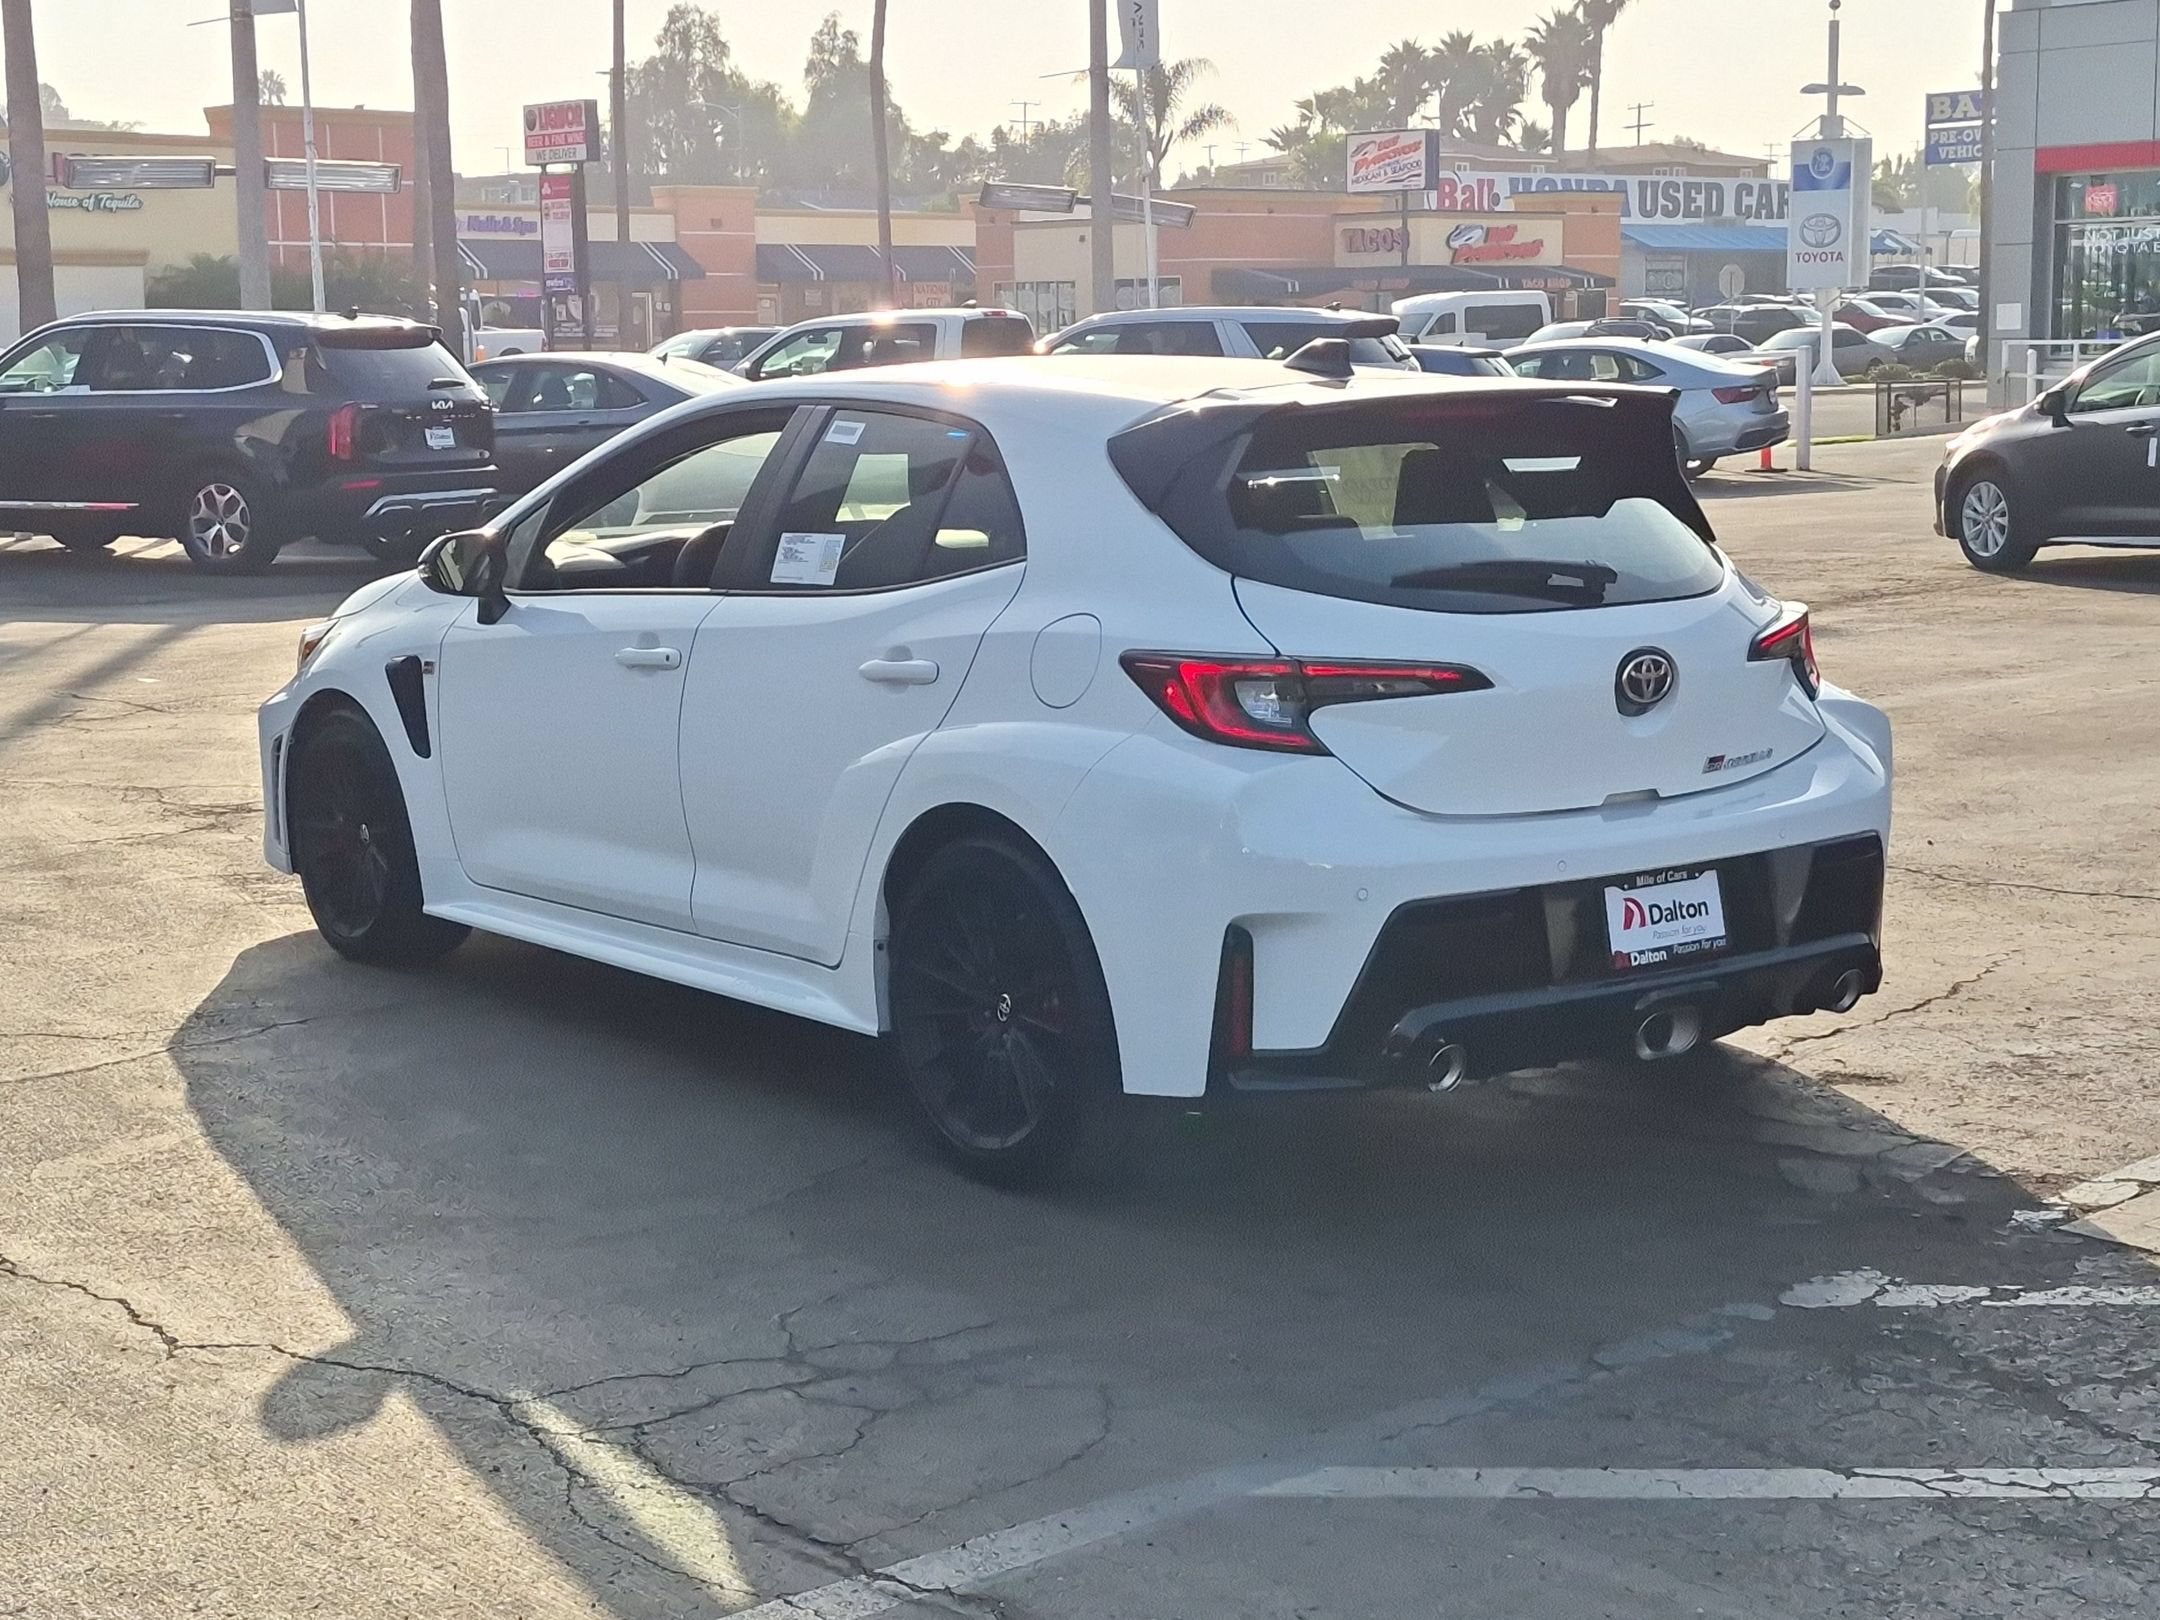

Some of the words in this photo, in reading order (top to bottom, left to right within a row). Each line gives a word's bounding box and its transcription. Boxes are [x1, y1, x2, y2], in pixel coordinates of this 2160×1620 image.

[1930, 94, 1983, 120] BA
[536, 149, 547, 160] WE
[549, 147, 577, 160] DELIVER
[82, 194, 95, 211] of
[98, 193, 141, 212] Tequila
[1638, 180, 1724, 218] USED
[1341, 228, 1410, 253] TACOS
[1795, 251, 1844, 263] TOYOTA
[1636, 875, 1654, 887] Mile
[1656, 871, 1666, 883] of
[1667, 870, 1687, 882] Cars
[1648, 899, 1709, 925] Dalton
[1630, 950, 1668, 967] Dalton
[1673, 942, 1700, 954] Passion
[1701, 939, 1711, 949] for
